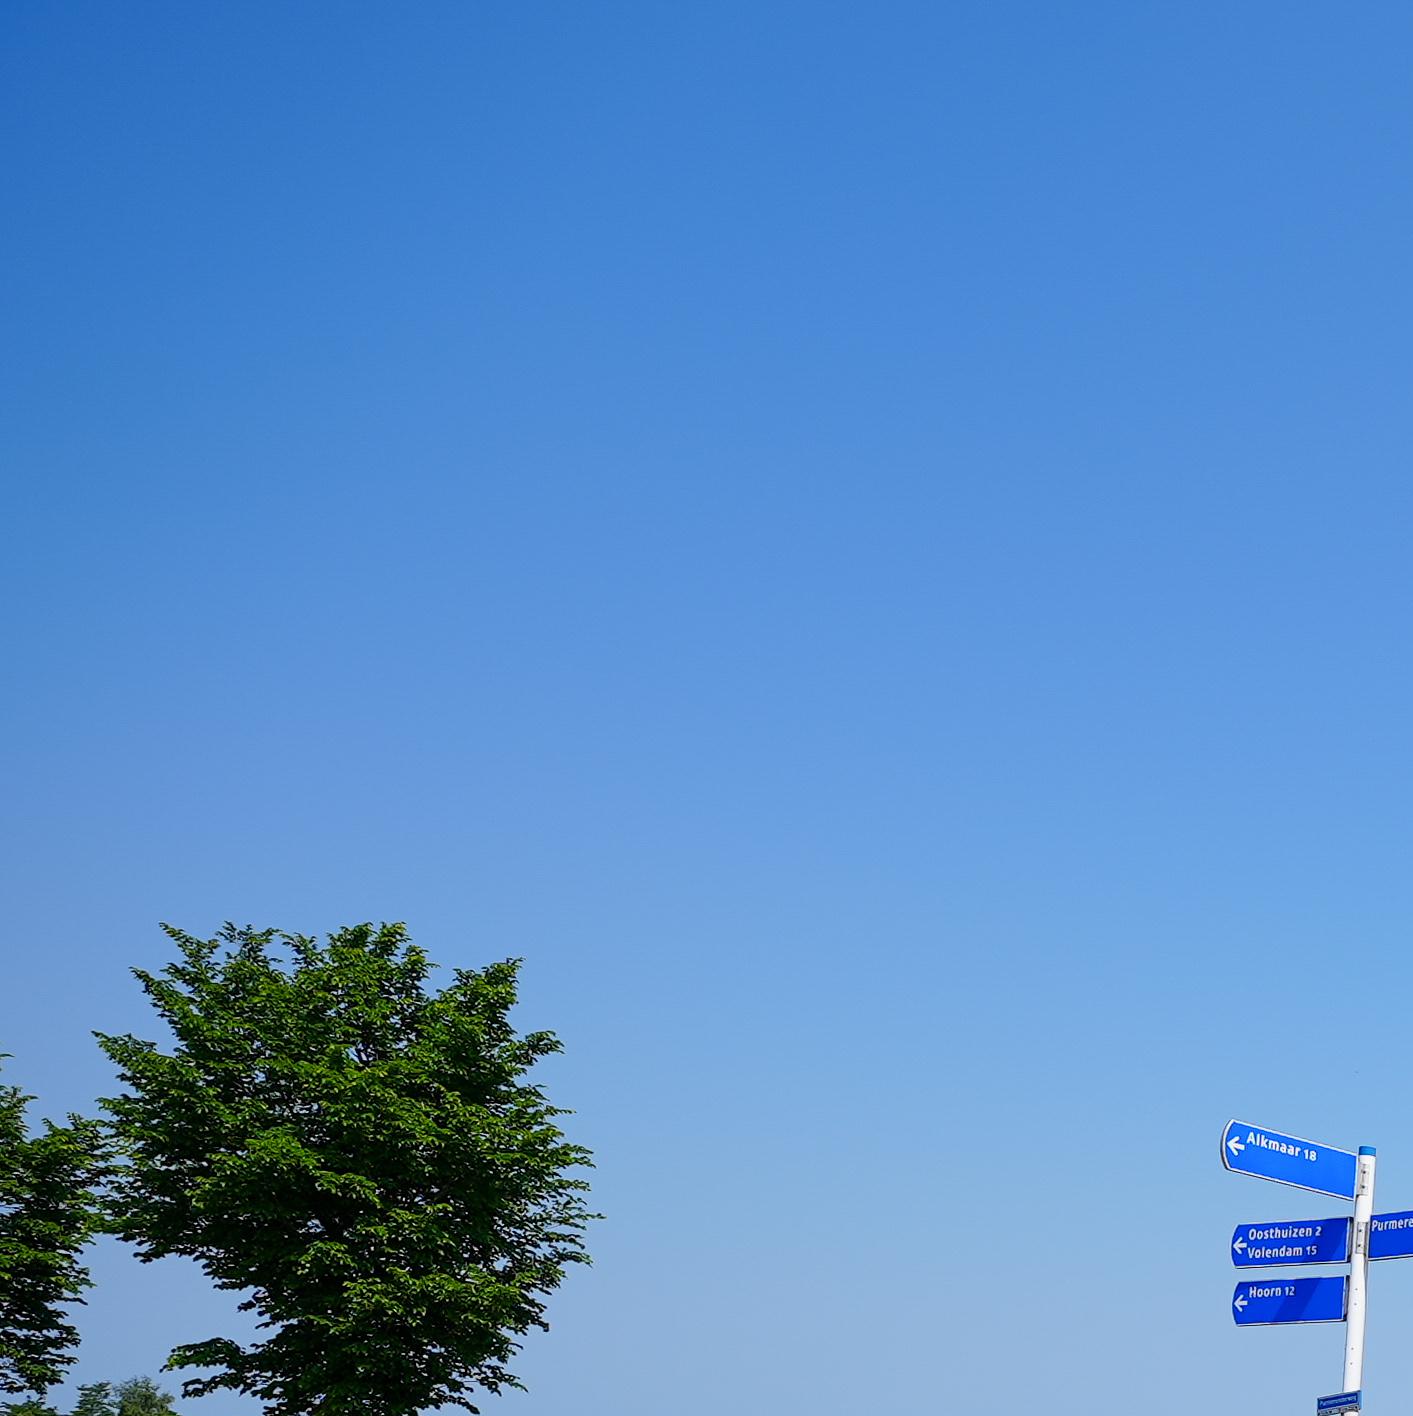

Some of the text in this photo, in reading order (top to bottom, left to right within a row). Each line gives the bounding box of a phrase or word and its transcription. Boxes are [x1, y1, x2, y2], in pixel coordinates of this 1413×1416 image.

[1246, 1131, 1317, 1162] Alkmaar 18
[1248, 1226, 1322, 1241] Oosthuizen 2
[1247, 1246, 1317, 1259] Volendam 15
[1249, 1286, 1296, 1298] Hoorn 12
